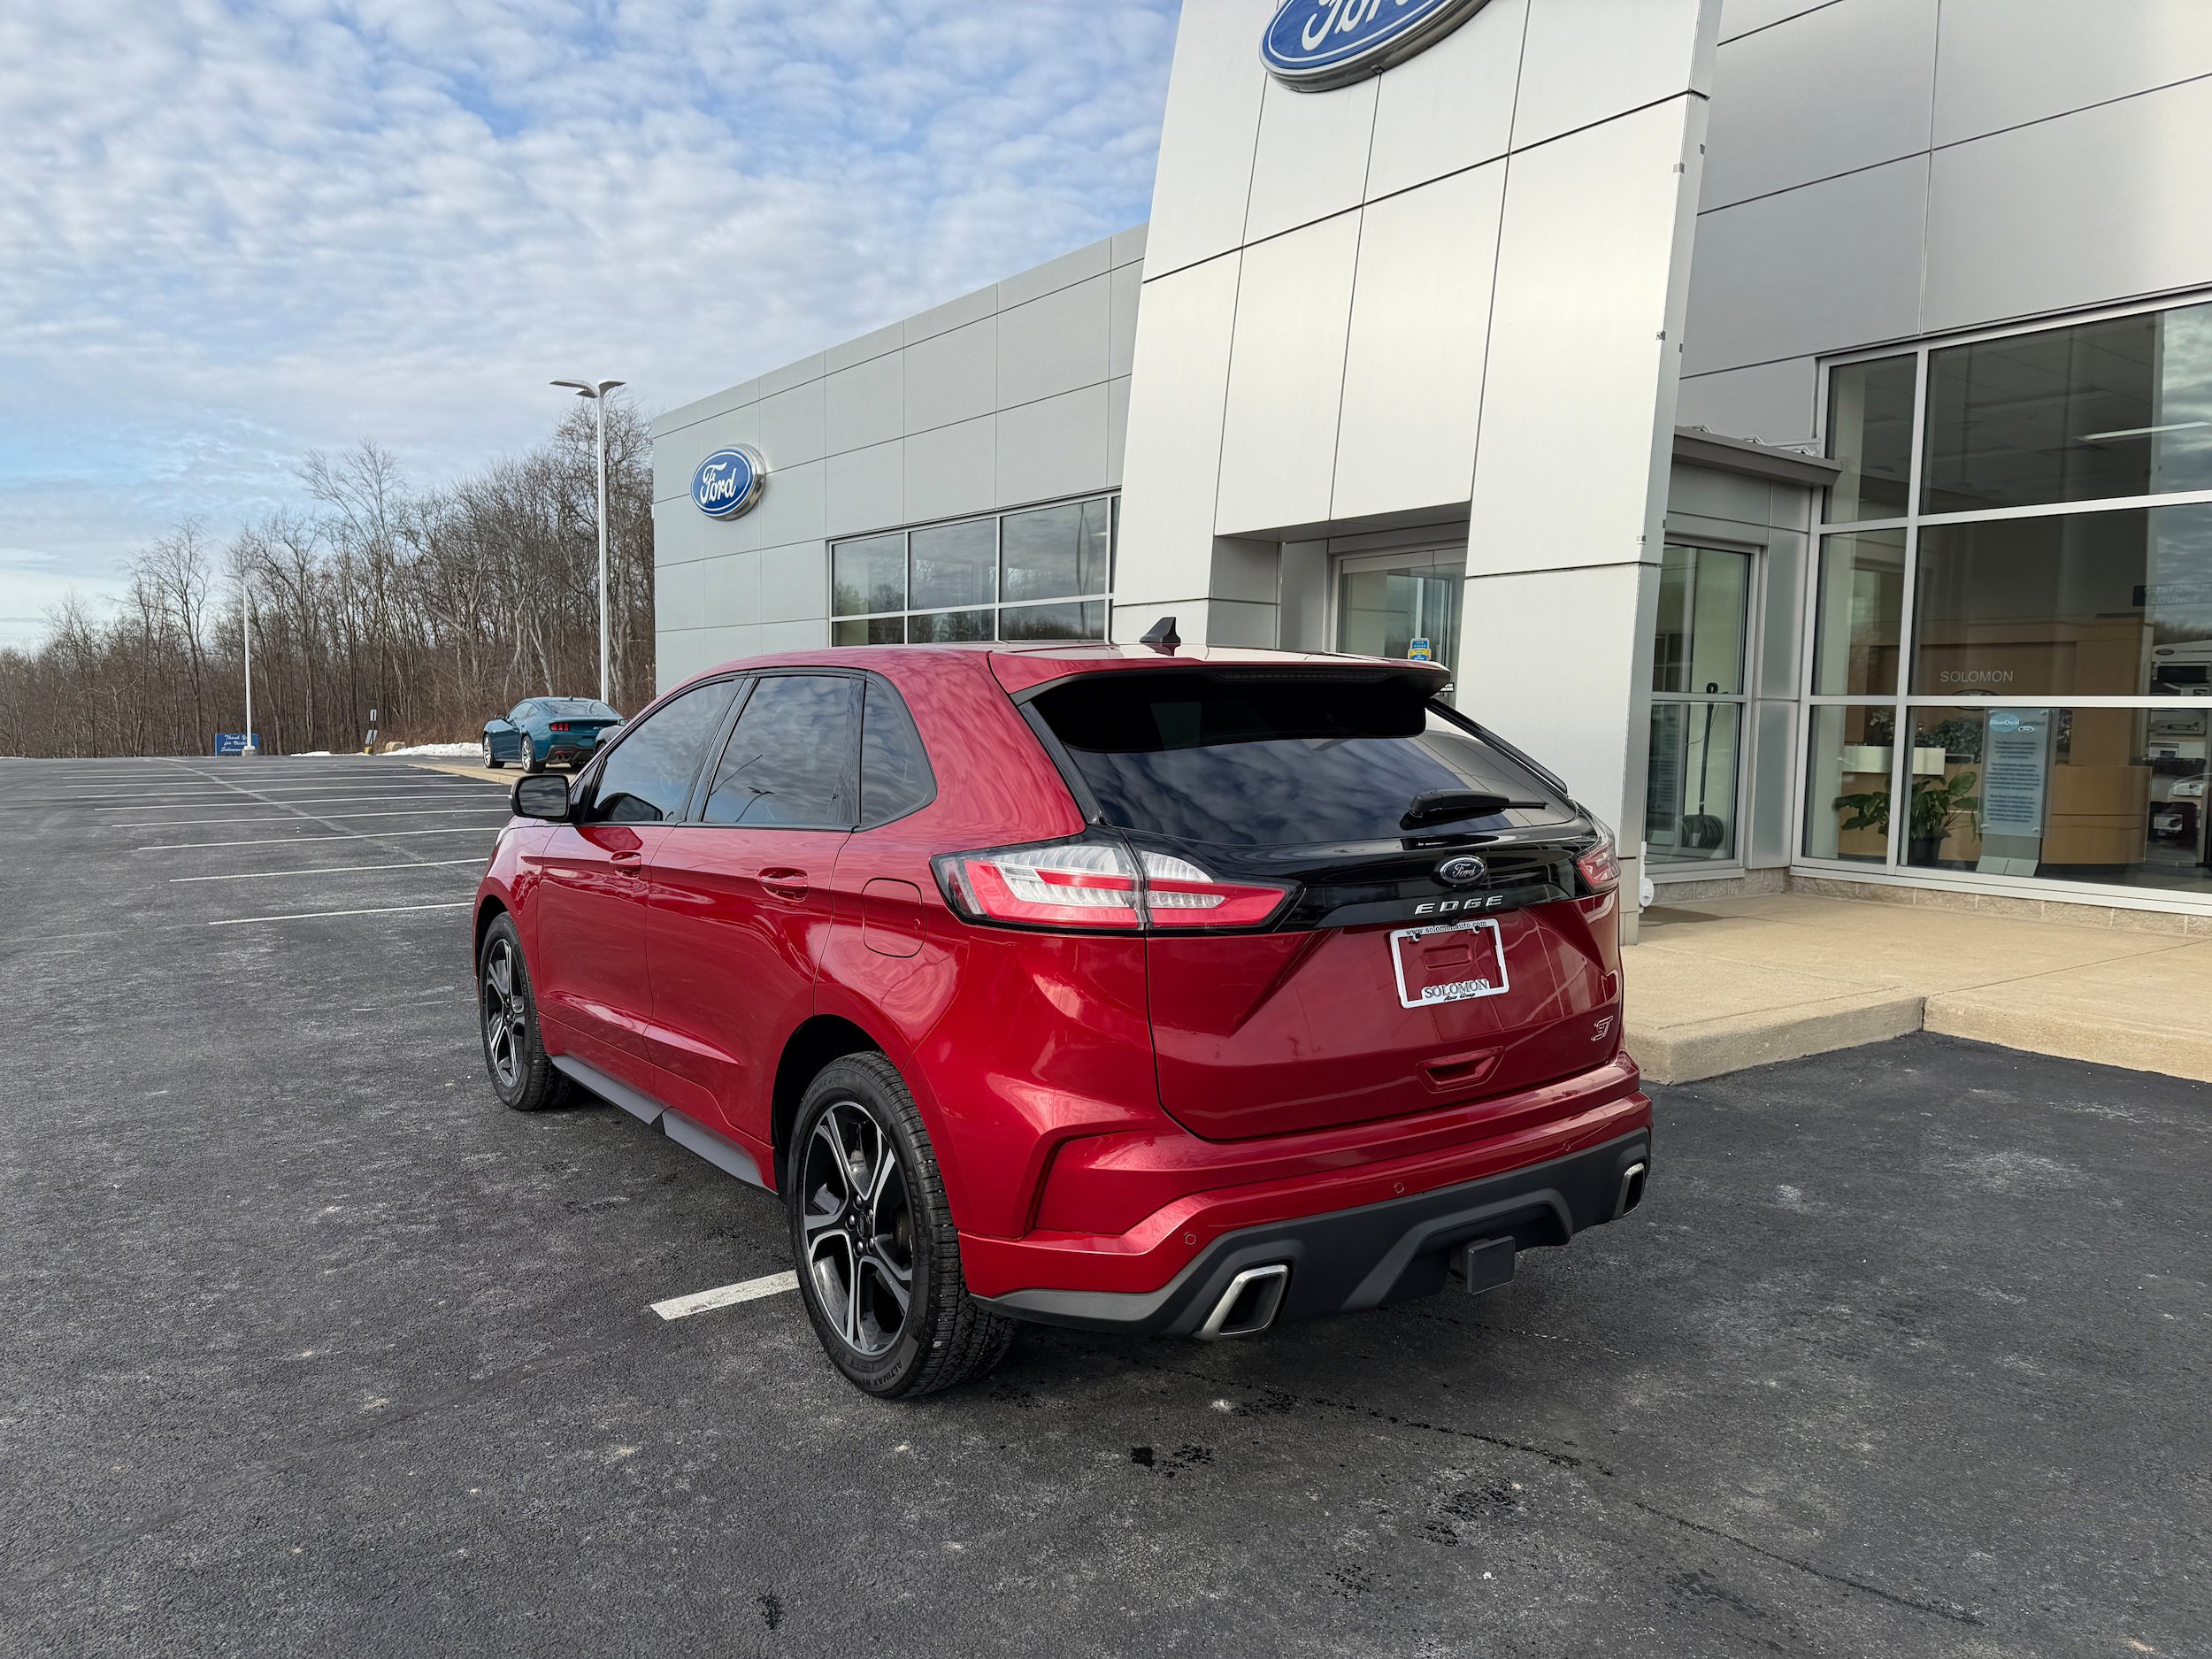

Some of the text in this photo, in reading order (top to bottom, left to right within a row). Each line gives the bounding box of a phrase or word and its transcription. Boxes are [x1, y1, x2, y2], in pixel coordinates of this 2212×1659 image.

[700, 461, 737, 504] Ford
[2145, 584, 2209, 594] CUSTOMER
[2153, 595, 2201, 604] LOUNGE
[1940, 670, 2014, 683] SOLOMON
[1452, 863, 1477, 878] Ford
[1415, 895, 1503, 915] EDGE
[1425, 979, 1488, 999] SOLOMON
